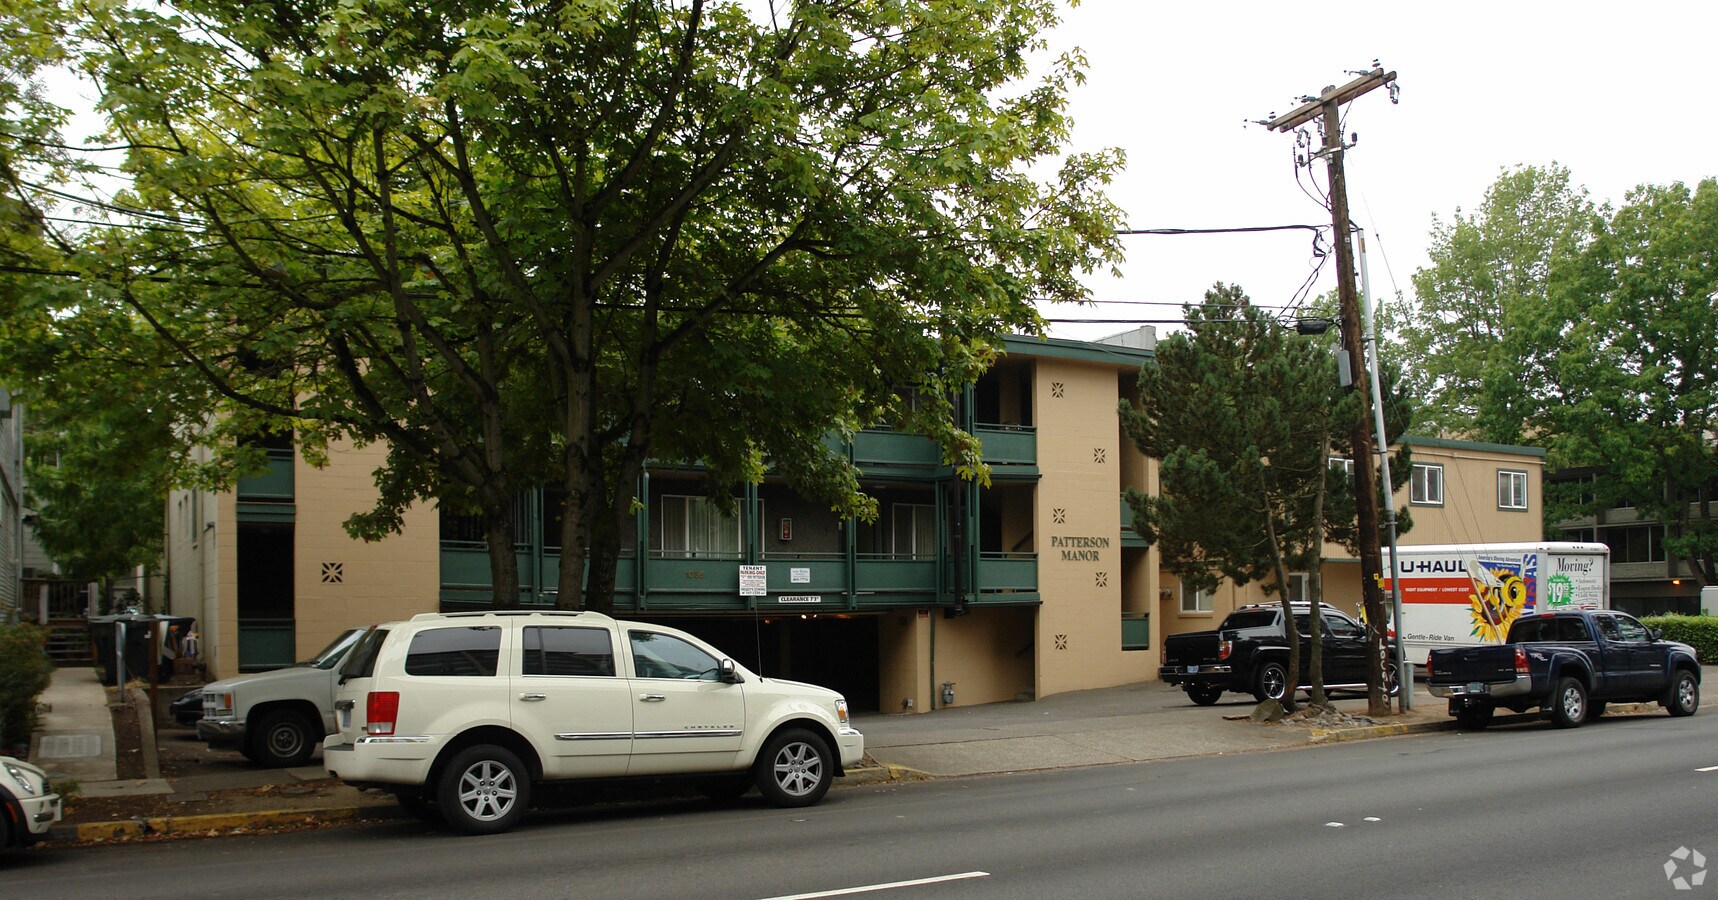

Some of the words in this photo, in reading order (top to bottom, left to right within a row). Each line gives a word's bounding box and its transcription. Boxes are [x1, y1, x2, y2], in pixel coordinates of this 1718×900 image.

[1051, 536, 1110, 548] PATTERSON
[1061, 550, 1099, 561] MANOR
[1401, 560, 1467, 573] U-HAUL
[1557, 558, 1594, 576] Moving?
